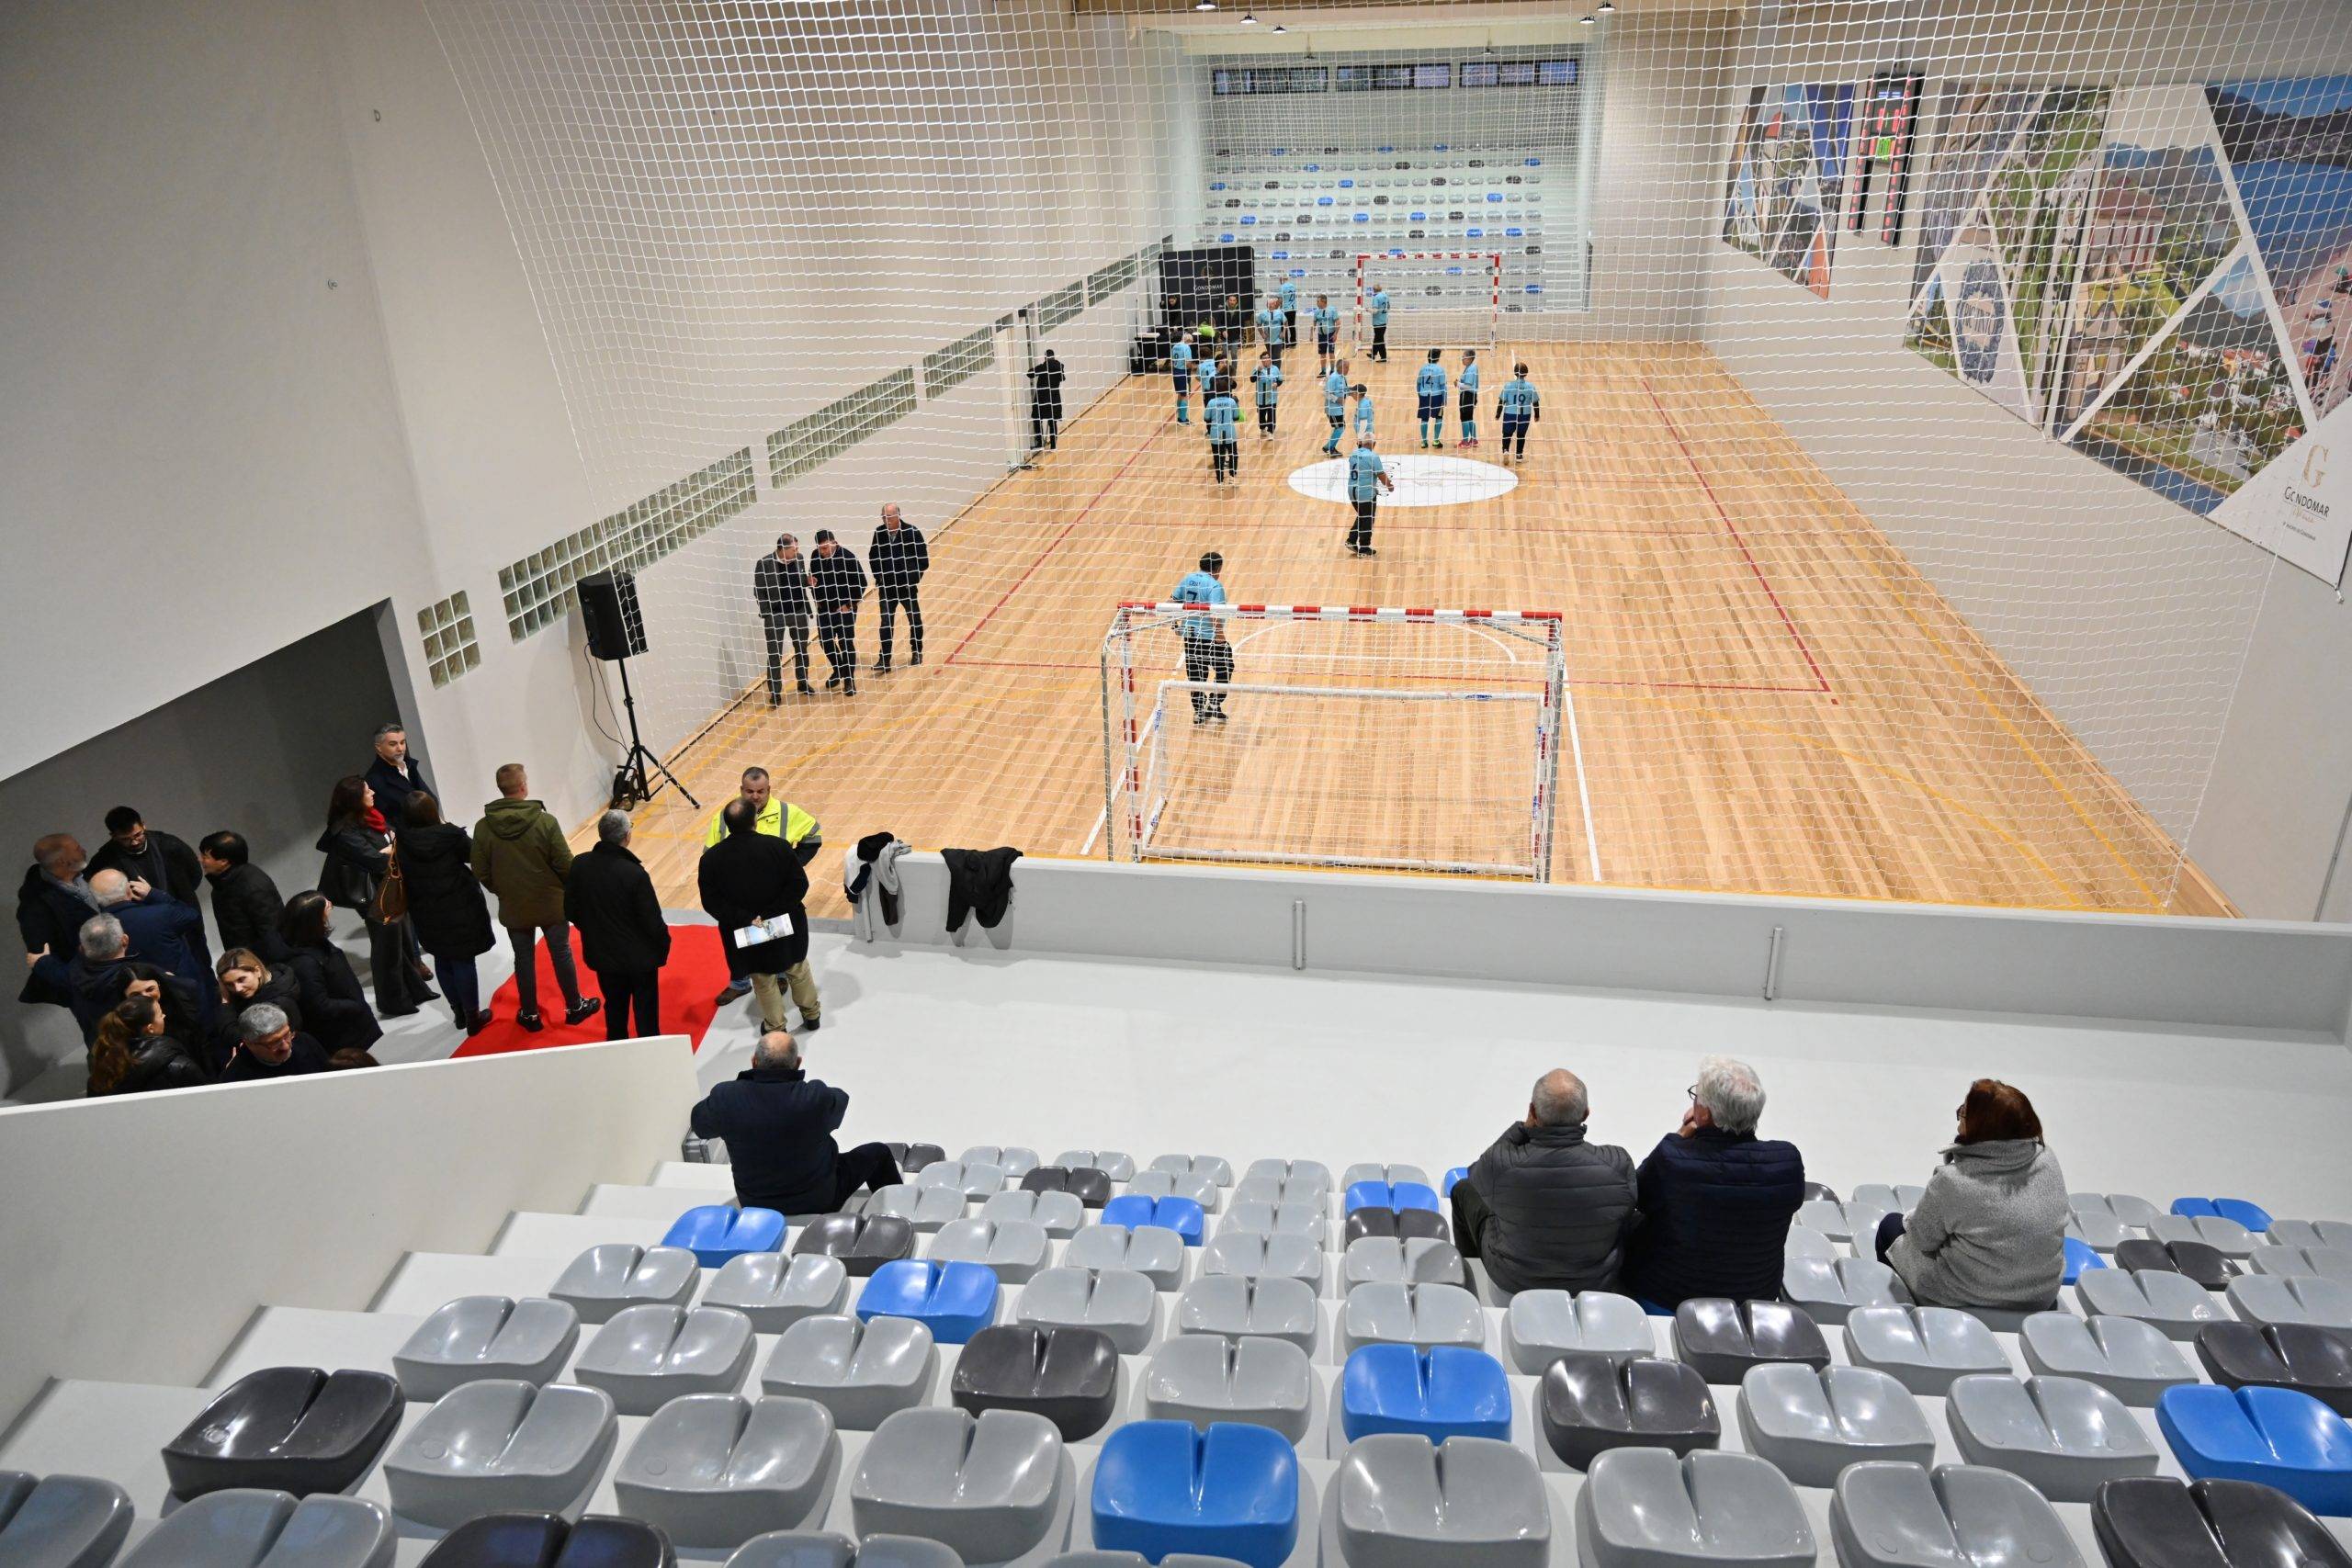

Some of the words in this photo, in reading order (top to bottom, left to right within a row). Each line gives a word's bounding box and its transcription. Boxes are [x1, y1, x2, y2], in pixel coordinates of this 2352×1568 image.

[1513, 394, 1526, 404] 19
[2303, 445, 2329, 488] G
[1187, 591, 1197, 604] 7
